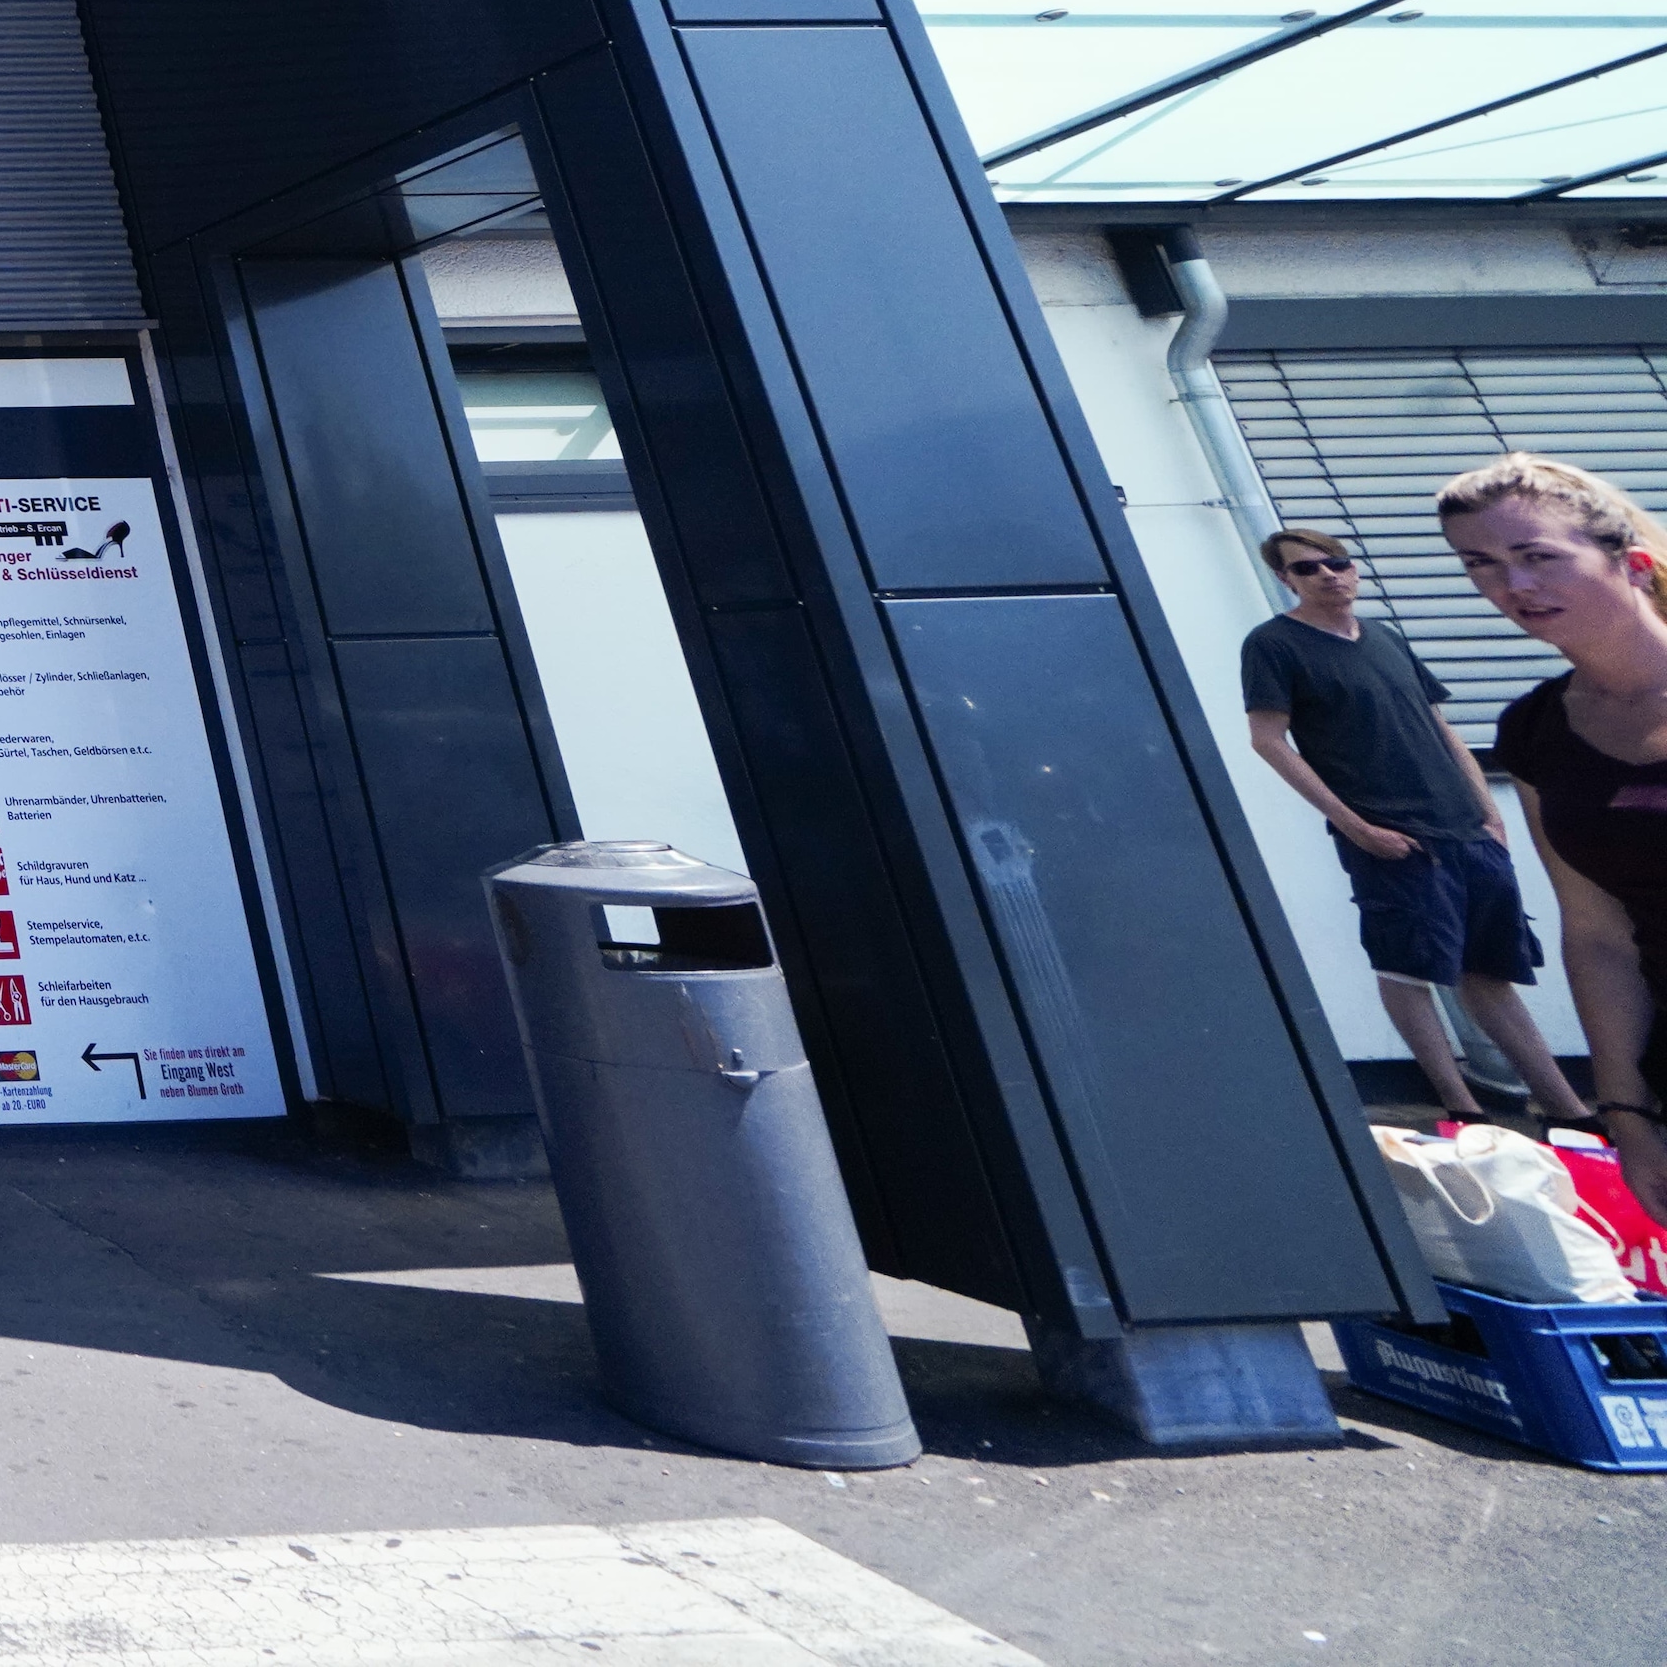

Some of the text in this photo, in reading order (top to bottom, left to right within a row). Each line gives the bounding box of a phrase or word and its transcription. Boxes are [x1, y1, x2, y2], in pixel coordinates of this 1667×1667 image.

[27, 524, 36, 532] S.
[38, 524, 62, 532] Ercan
[3, 569, 12, 581] &
[17, 566, 138, 580] Schlüsseldienst
[64, 616, 127, 626] Schnürsenkel,
[46, 630, 86, 641] Einlagen
[35, 673, 76, 684] Zylinder,
[78, 671, 150, 682] Schließanlagen,
[31, 747, 72, 757] Taschen,
[74, 746, 128, 756] Geldbörsen
[129, 746, 152, 754] e.t.c.
[5, 793, 167, 806] Uhrenarmbänder, Uhrenbatterien,
[7, 811, 52, 821] Batterien
[17, 861, 89, 873] Schildgravuren
[19, 876, 34, 886] für
[36, 876, 63, 886] Haus,
[64, 875, 91, 884] Hund
[93, 874, 112, 883] und
[114, 873, 136, 883] Katz
[27, 918, 103, 932] Stempelservice,
[29, 933, 151, 946] Stempelautomaten, e.t.c.
[39, 981, 112, 992] Schleifarbeiten
[41, 993, 149, 1007] für den Hausgebrauch
[144, 1046, 246, 1061] Sie finden uns direkt am
[161, 1062, 235, 1082] Eingang West
[160, 1082, 244, 1098] neben Blumen Groth
[2, 1101, 10, 1111] ab
